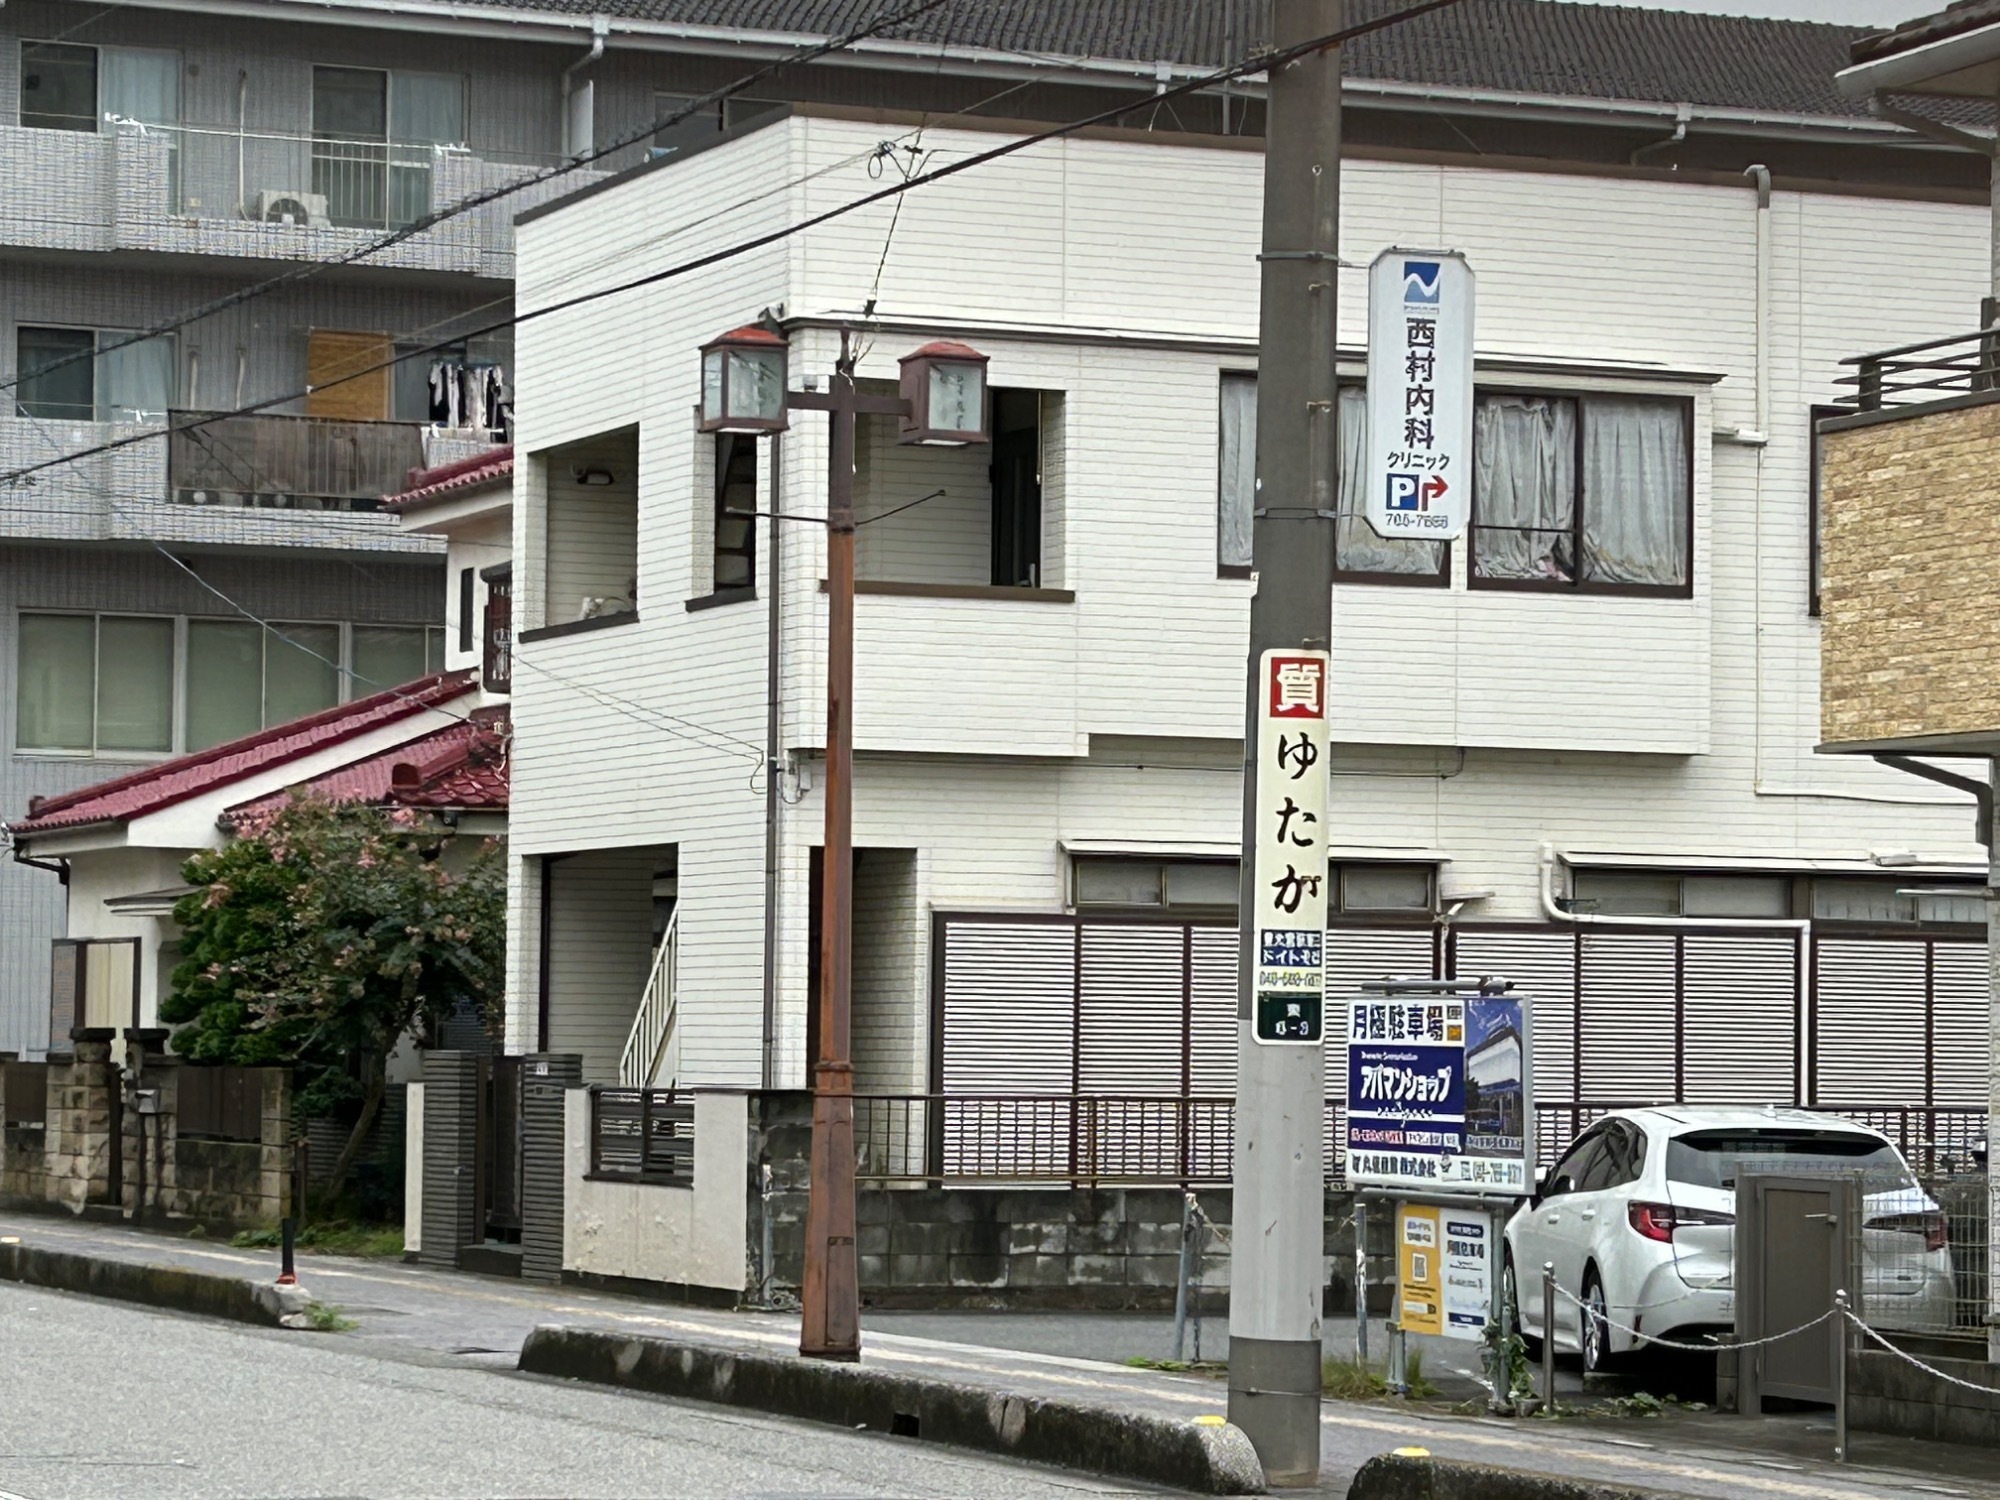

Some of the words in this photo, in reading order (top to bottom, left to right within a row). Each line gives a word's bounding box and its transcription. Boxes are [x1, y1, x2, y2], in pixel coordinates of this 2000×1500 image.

[1404, 317, 1437, 450] 西村内科
[1387, 451, 1450, 471] クリニック
[1391, 477, 1415, 508] P
[1276, 663, 1321, 713] 質
[1360, 1063, 1452, 1102] アパマンショップ
